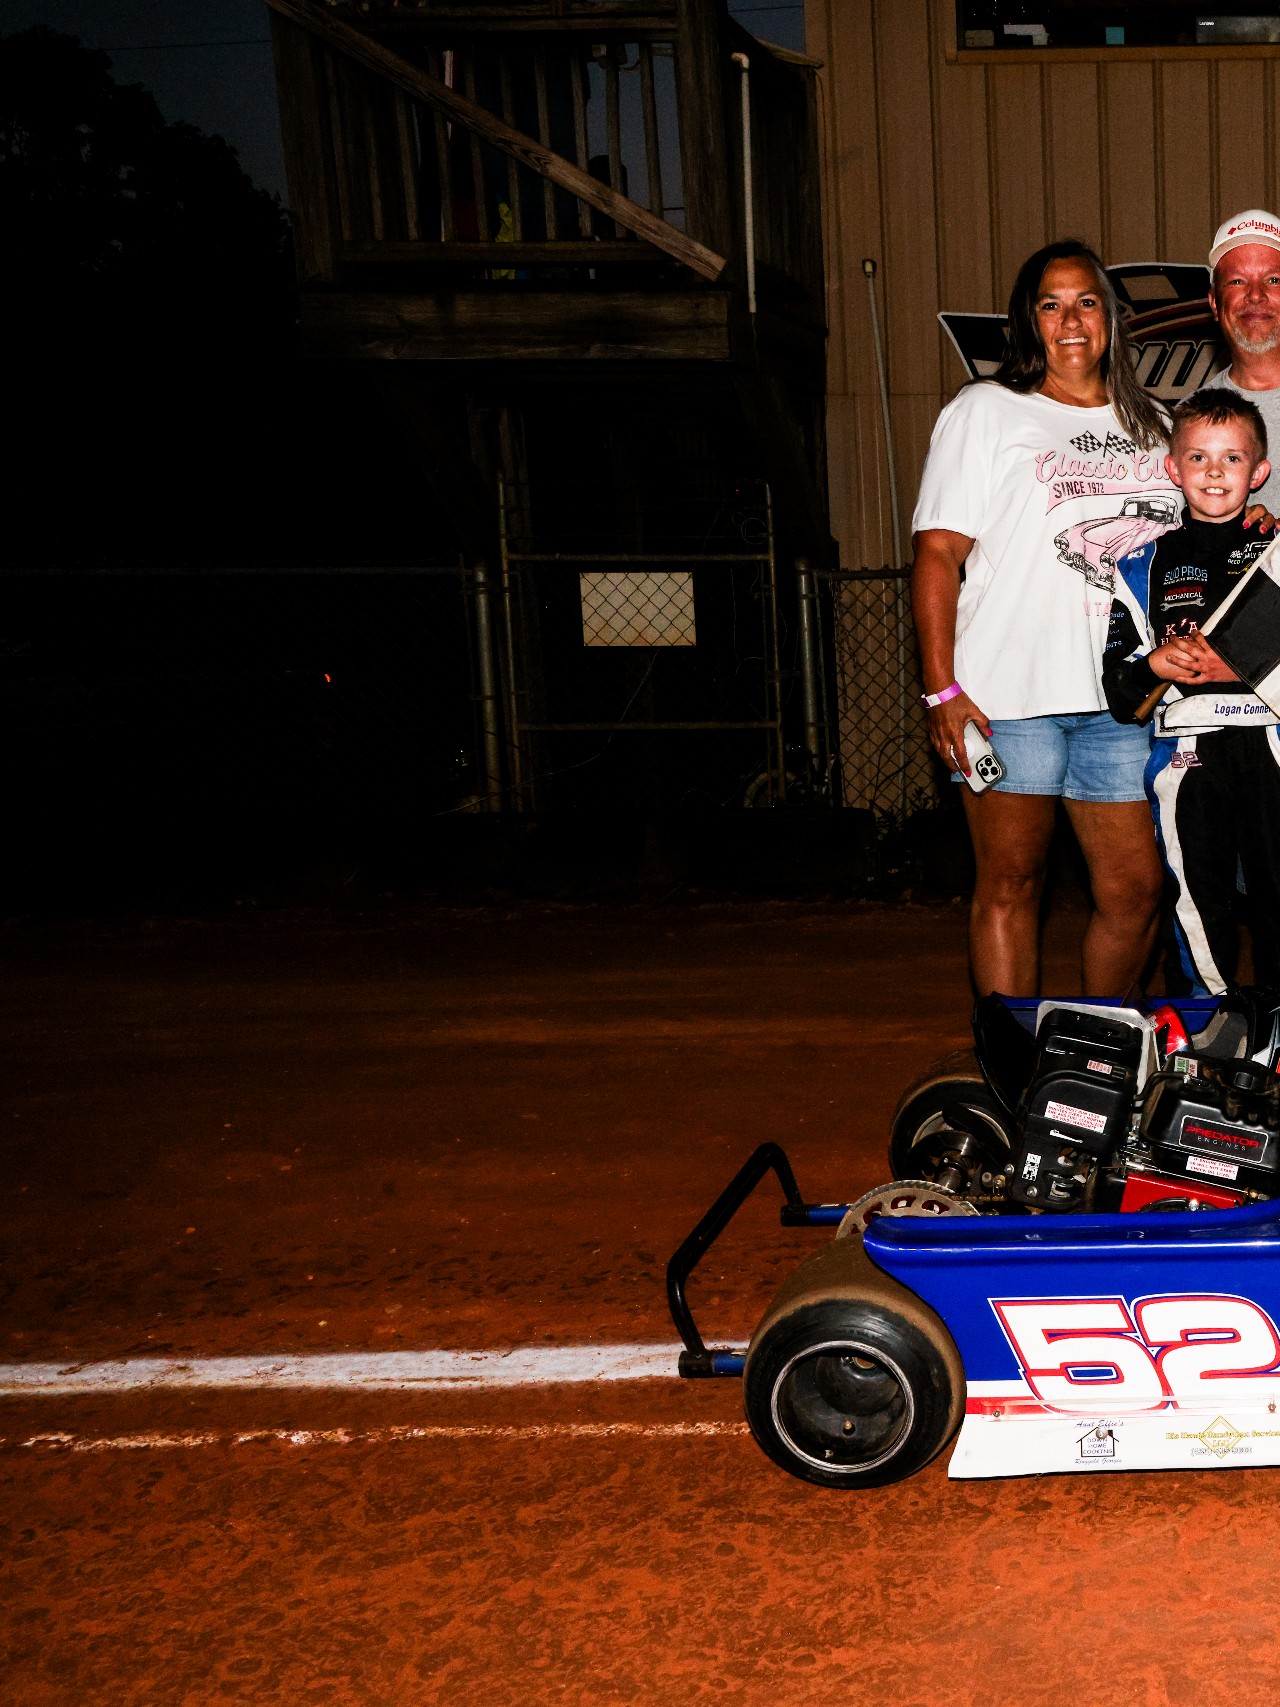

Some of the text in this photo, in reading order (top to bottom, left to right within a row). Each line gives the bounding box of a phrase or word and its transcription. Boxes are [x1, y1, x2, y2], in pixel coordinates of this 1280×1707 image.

[1035, 449, 1128, 483] Classic
[1053, 481, 1104, 498] SINCE 1972
[1181, 566, 1208, 579] PROS
[1164, 592, 1202, 602] MECHANICAL
[1214, 704, 1242, 716] Logan
[1171, 751, 1202, 768] 52
[1185, 1125, 1260, 1148] PREDATOR
[1198, 1136, 1246, 1150] ENGINES
